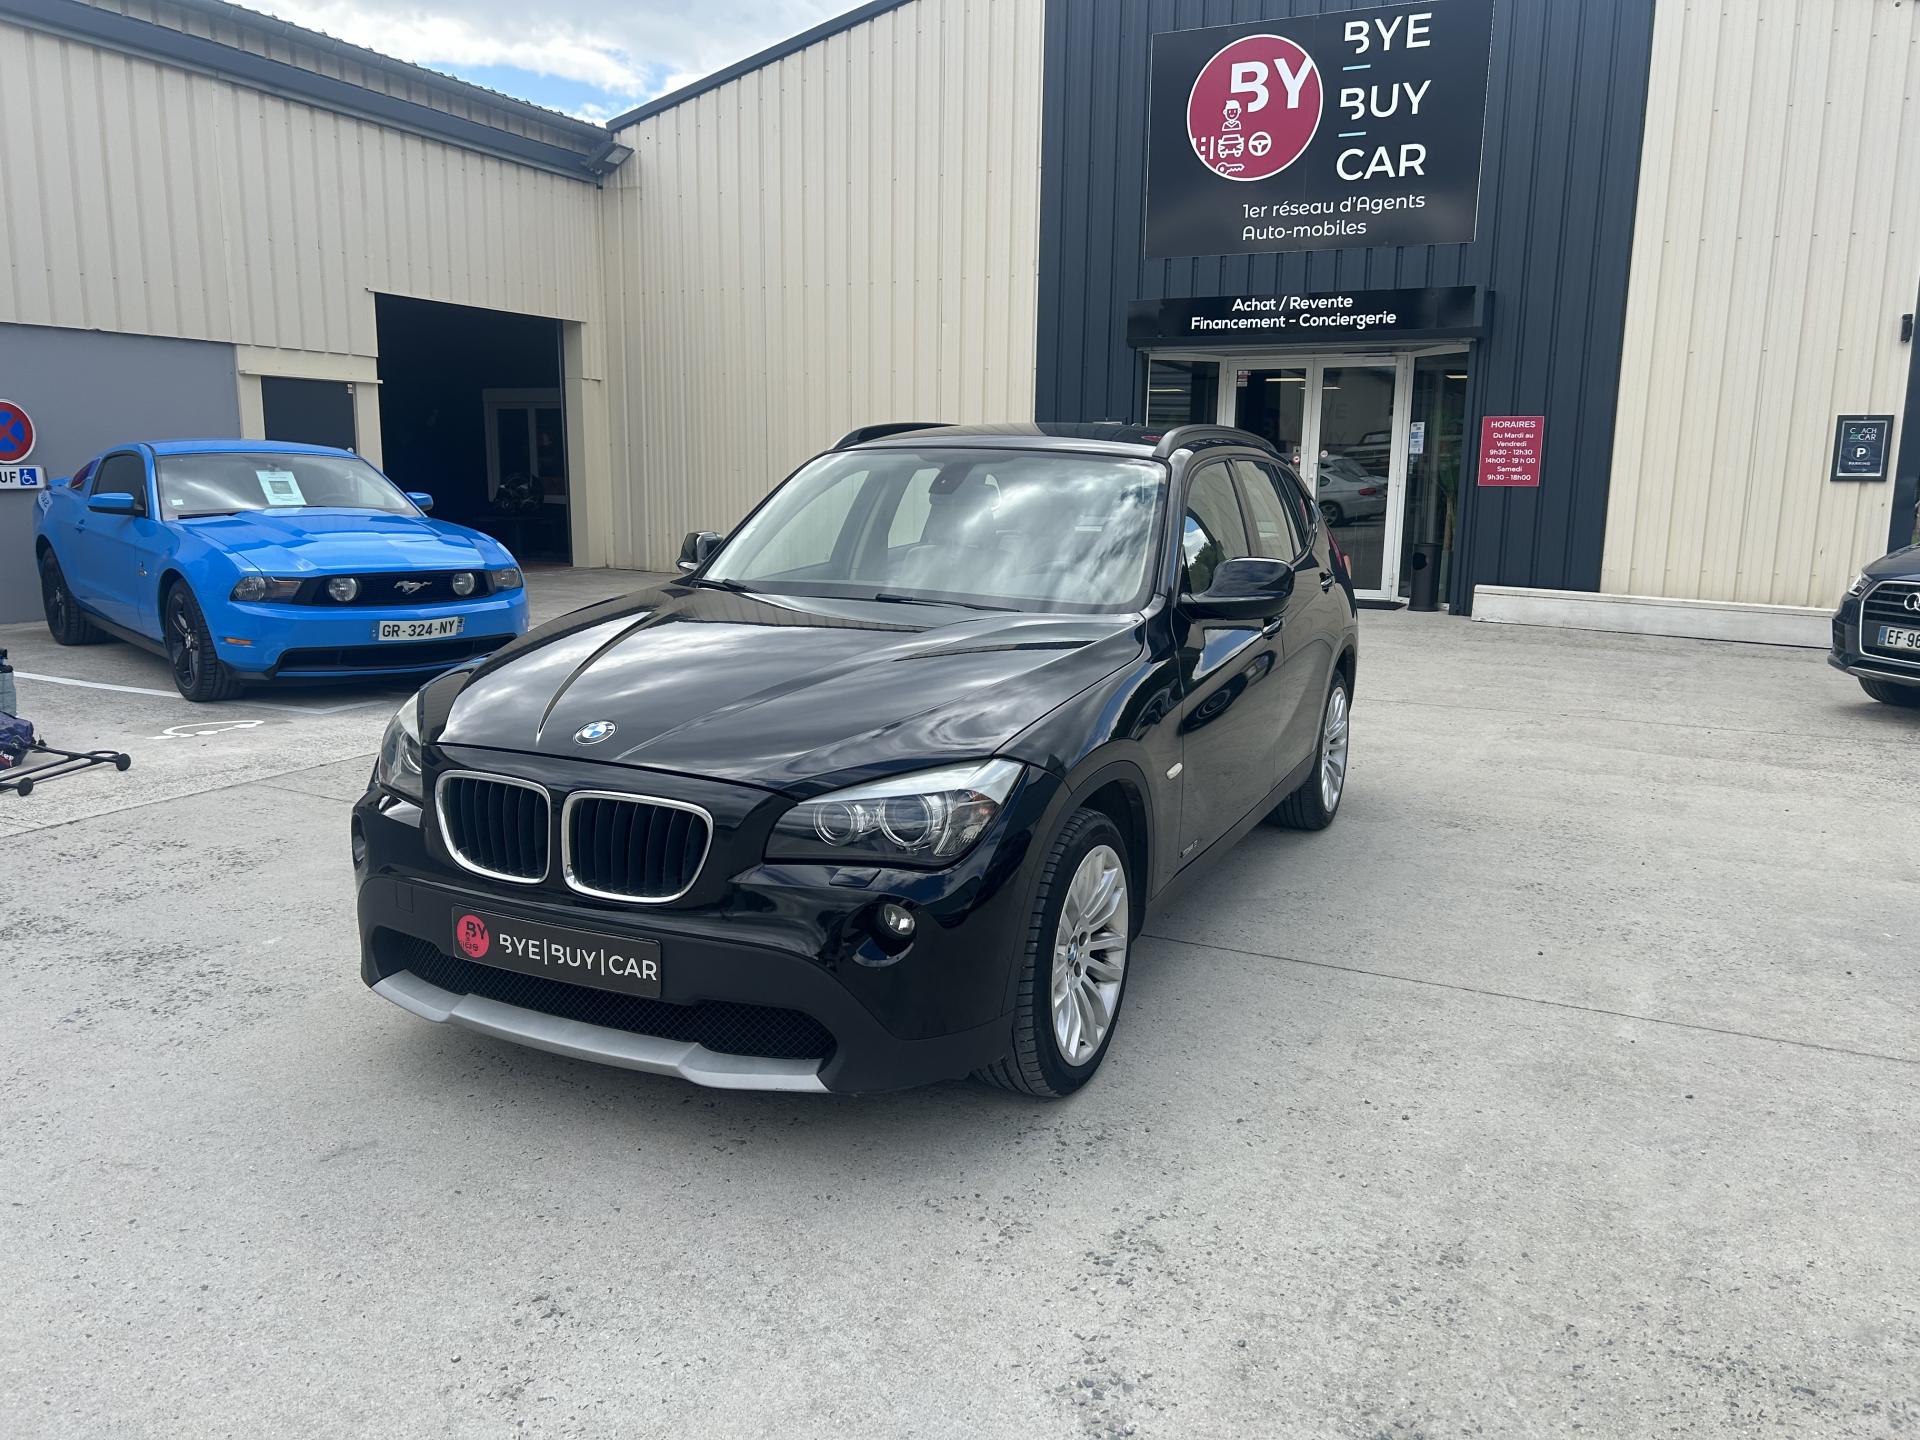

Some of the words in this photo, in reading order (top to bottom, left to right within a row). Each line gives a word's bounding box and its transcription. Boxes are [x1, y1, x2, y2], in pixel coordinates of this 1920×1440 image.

[1344, 12, 1432, 54] BYE
[1230, 56, 1314, 113] BY
[1340, 79, 1432, 120] BUY
[1336, 143, 1427, 181] CAR
[1242, 203, 1267, 218] 1er
[1272, 201, 1334, 217] réseau
[1242, 220, 1367, 240] Auto-mobiles
[1232, 298, 1276, 312] Achat
[1289, 296, 1353, 310] Revente
[1190, 315, 1286, 330] Financement
[1299, 311, 1397, 329] Conciergerie
[1858, 433, 1877, 441] CAR
[1856, 447, 1867, 458] P
[382, 620, 455, 637] GR-324-NY
